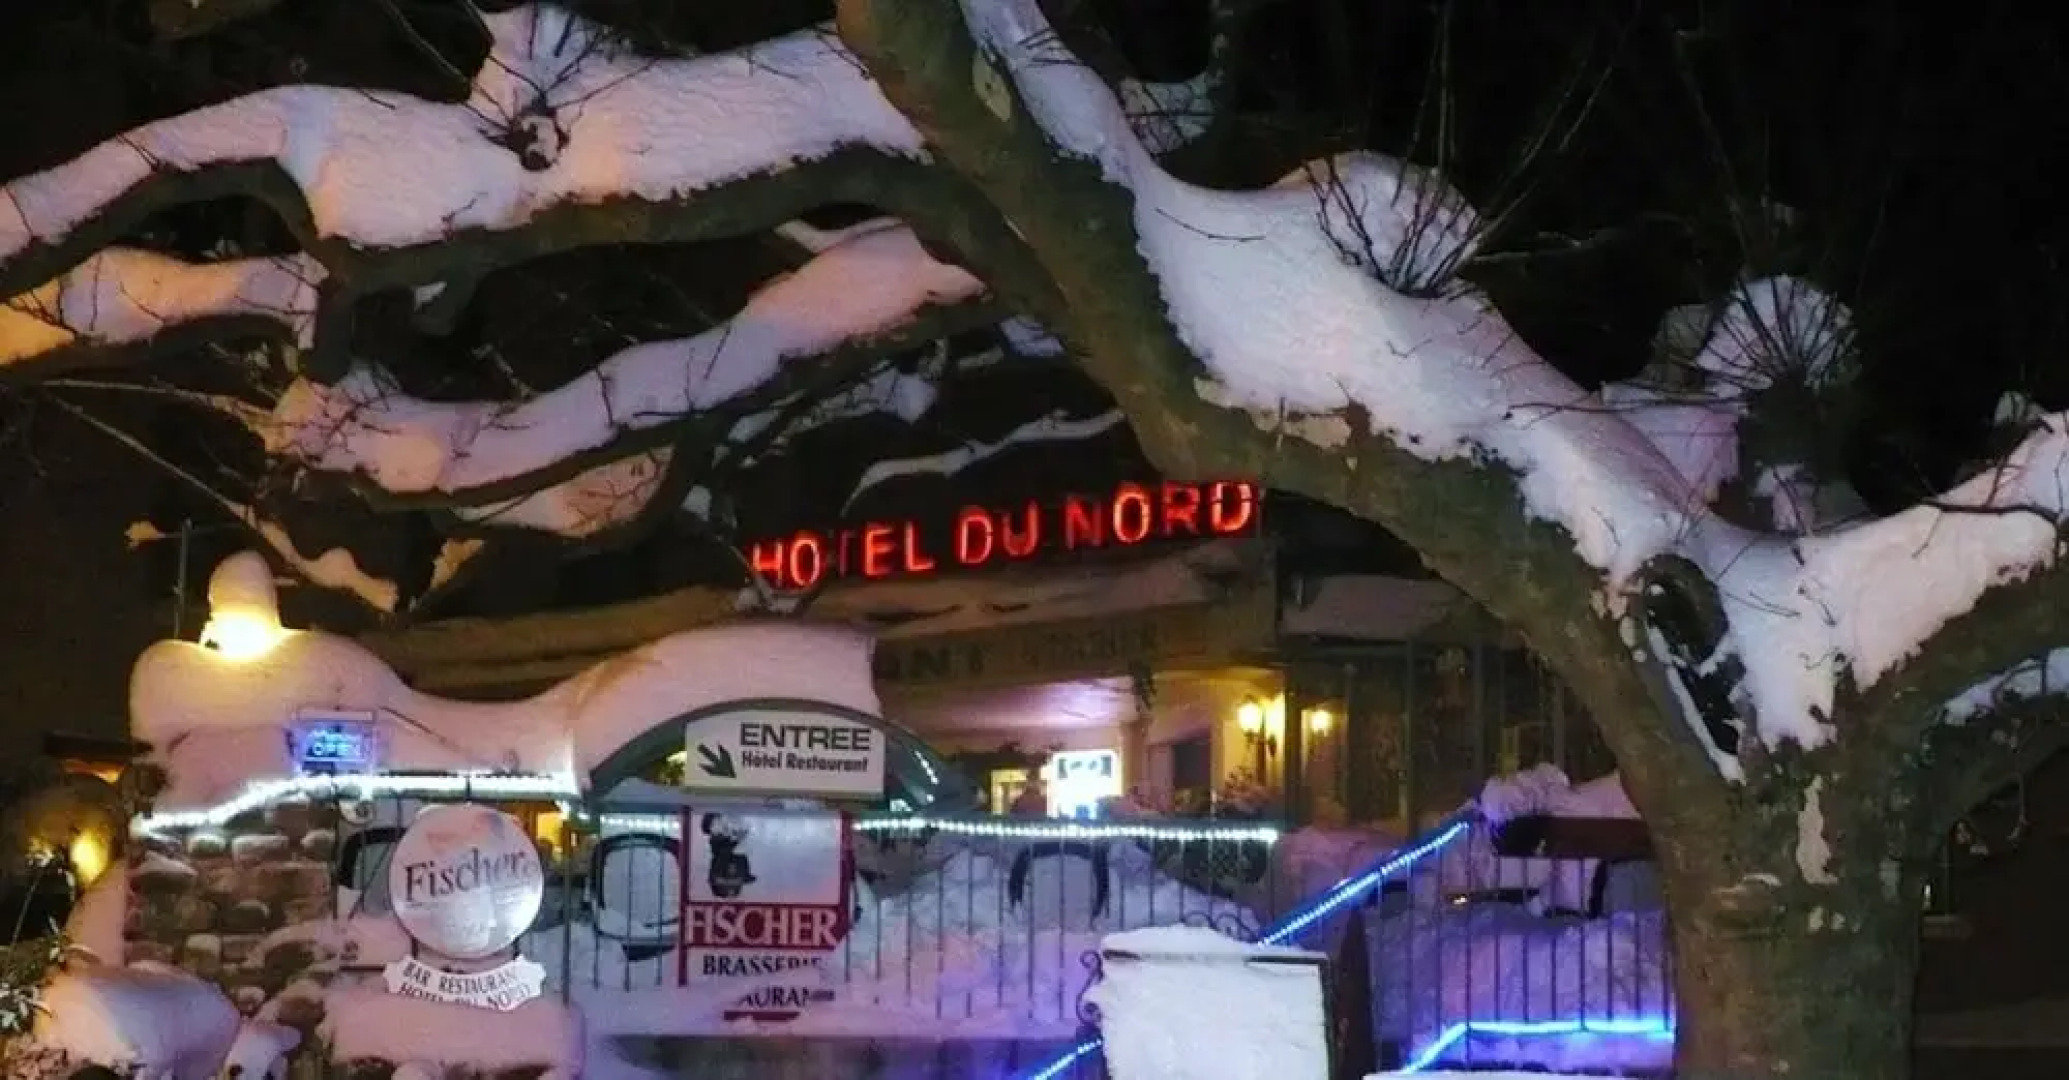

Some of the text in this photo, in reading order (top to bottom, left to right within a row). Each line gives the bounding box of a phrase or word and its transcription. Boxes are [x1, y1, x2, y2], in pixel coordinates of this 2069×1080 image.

[751, 480, 1255, 588] HOTEL DU NORD
[740, 723, 871, 751] ENTREE
[786, 753, 868, 773] Restaurant
[686, 905, 836, 946] FISCHER
[403, 961, 517, 994] BAR RESTAURAN
